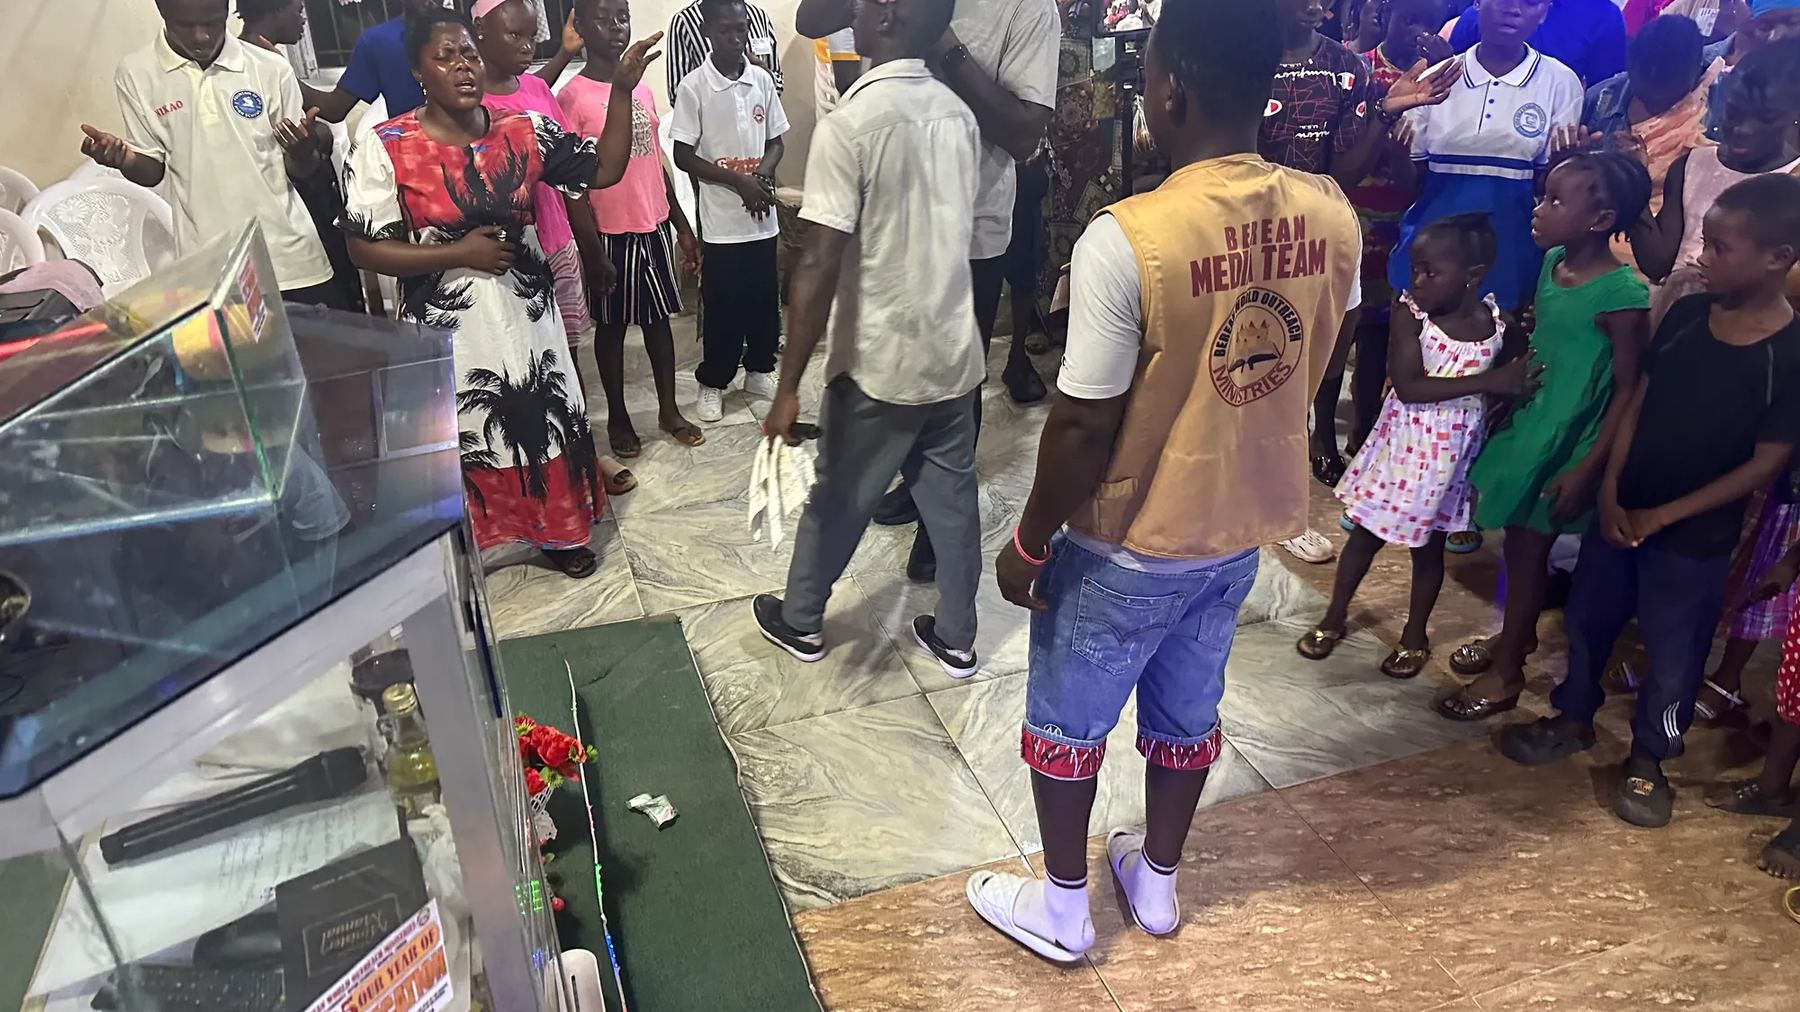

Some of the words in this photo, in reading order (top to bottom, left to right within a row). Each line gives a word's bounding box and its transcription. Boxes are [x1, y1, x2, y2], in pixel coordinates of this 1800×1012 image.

[1261, 238, 1327, 281] TEAM
[1260, 293, 1302, 342] OUTREACH
[1213, 361, 1292, 404] MINISTRIES
[358, 976, 385, 1007] OUR
[386, 945, 418, 981] YEAR
[420, 929, 435, 952] OF
